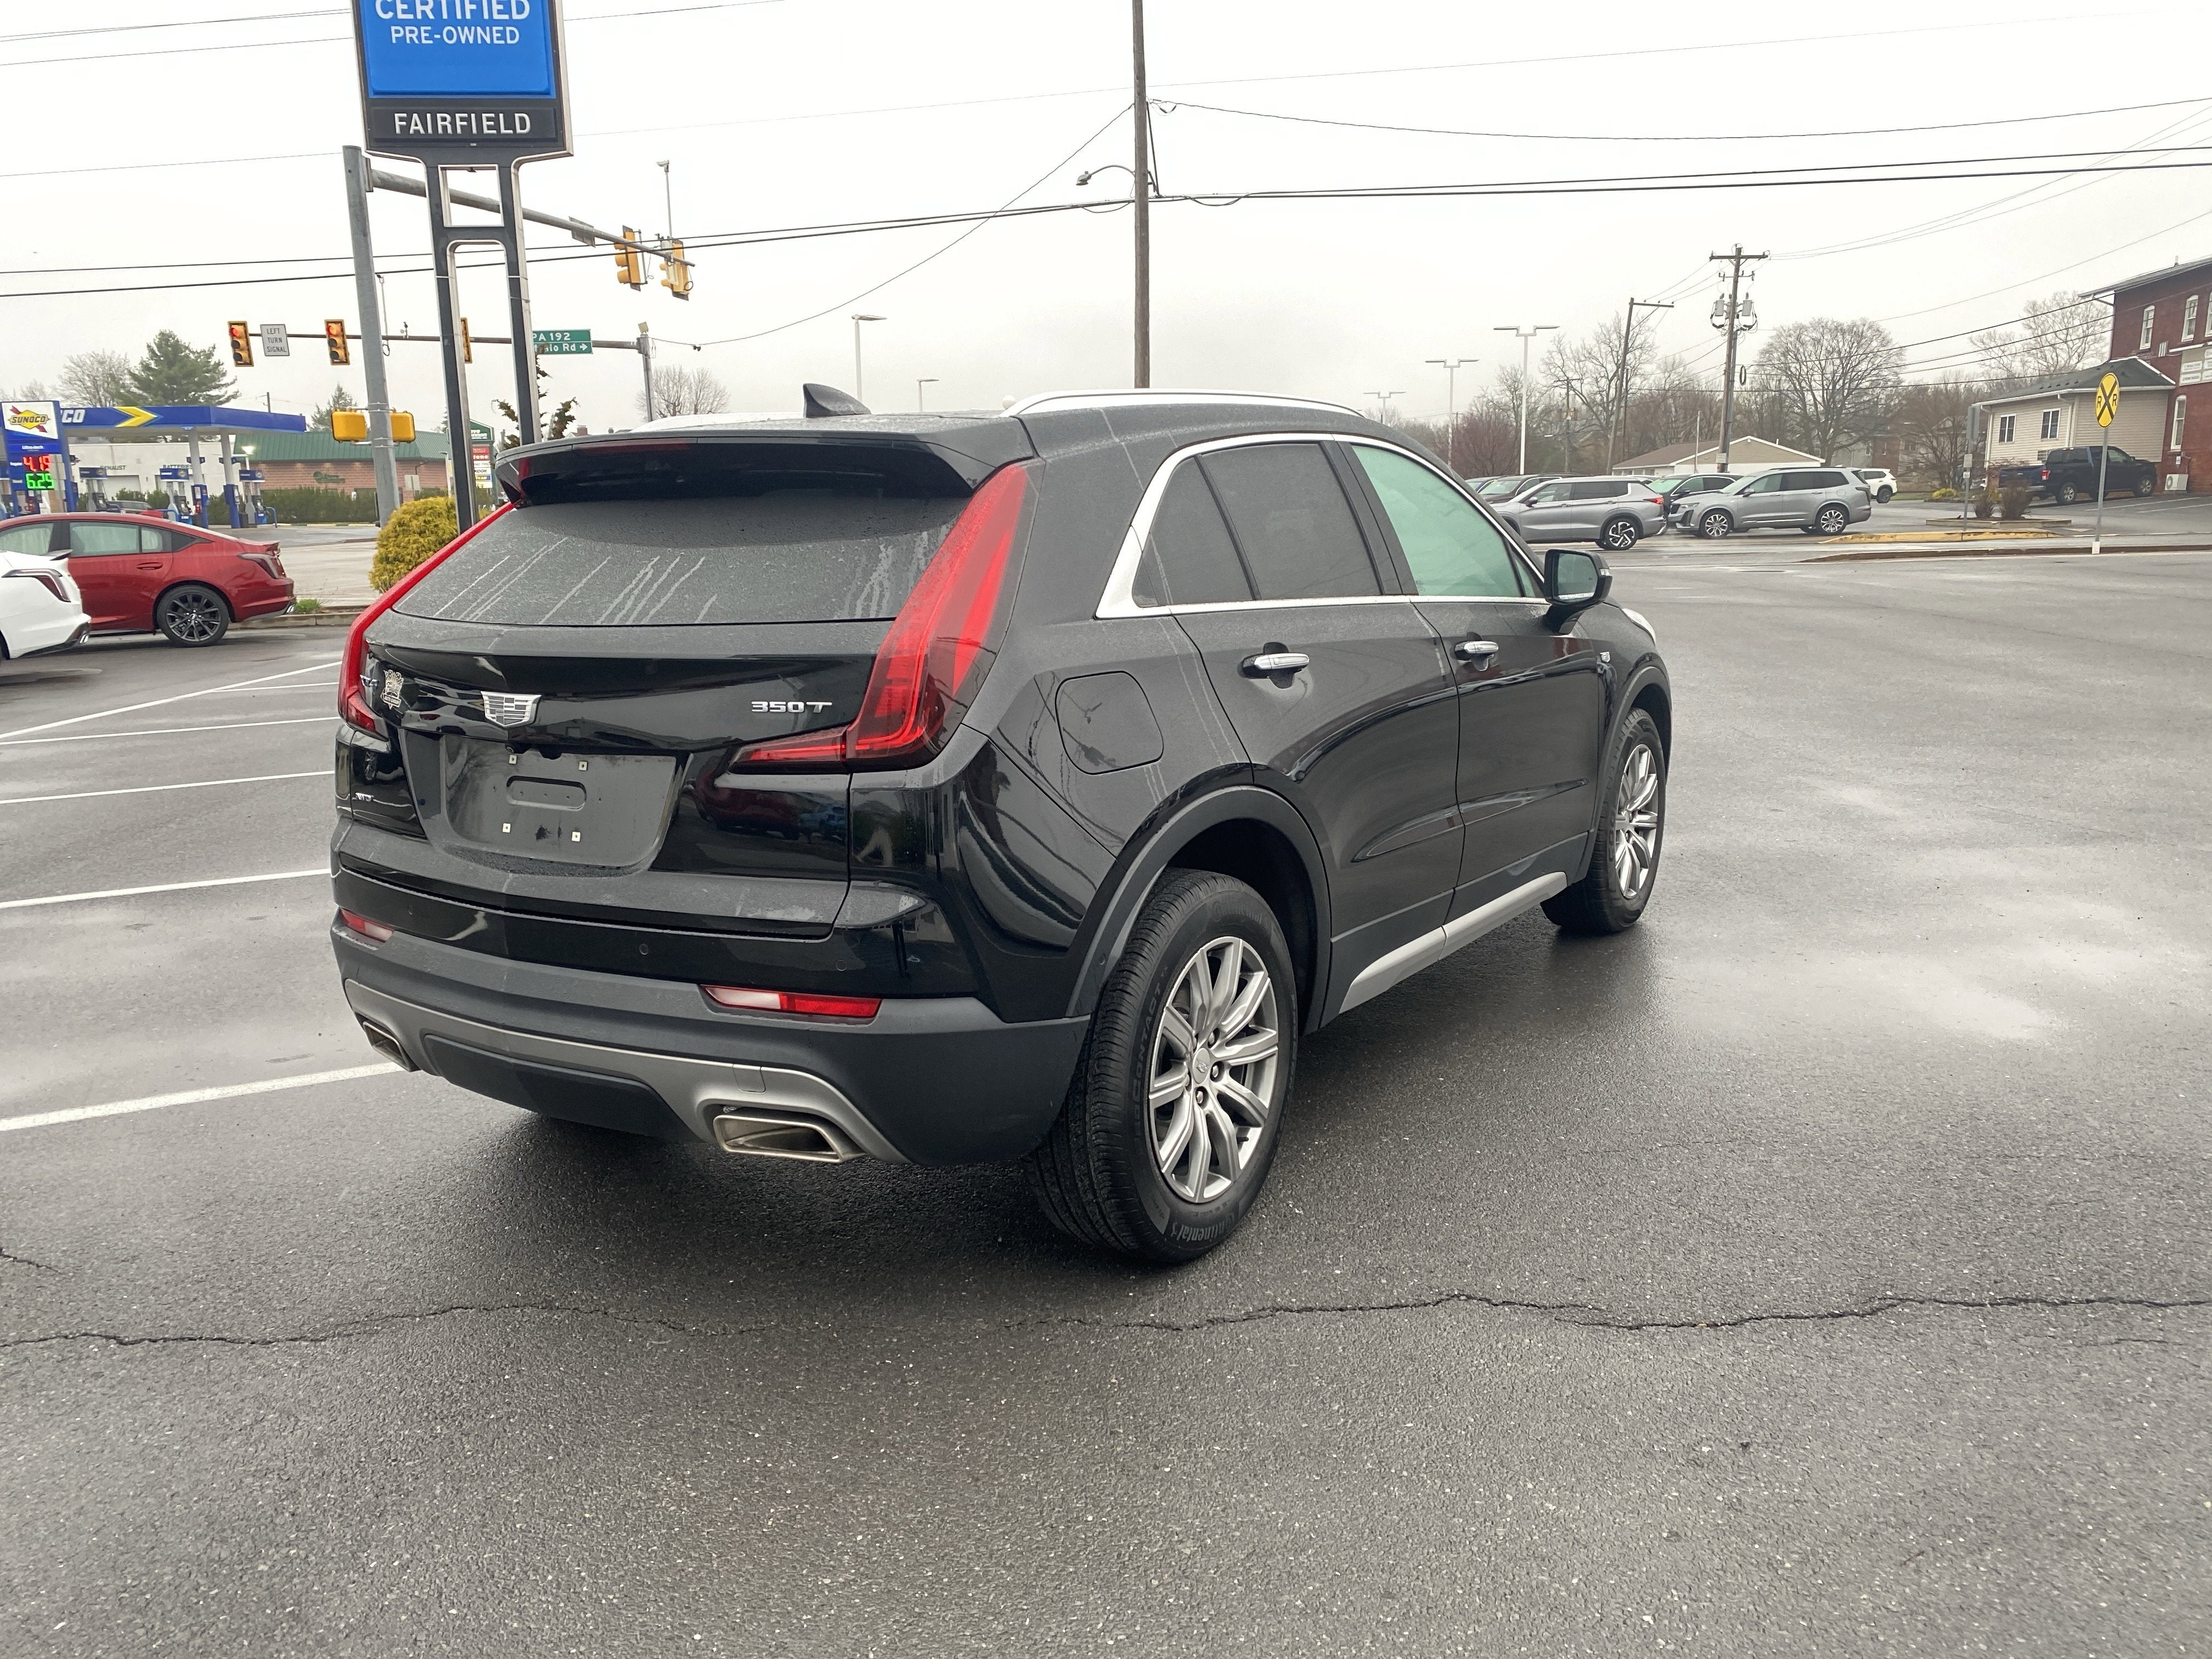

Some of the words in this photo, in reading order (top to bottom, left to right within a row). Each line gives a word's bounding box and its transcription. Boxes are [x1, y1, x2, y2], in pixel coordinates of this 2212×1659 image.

[375, 0, 531, 20] CERTIFIED
[390, 26, 520, 45] PRE-OWNED
[394, 112, 532, 135] FAIRFIELD
[532, 332, 546, 341] PA
[549, 332, 571, 341] 192
[562, 343, 576, 351] Rd
[2097, 396, 2102, 409] R
[2112, 393, 2117, 407] R
[60, 409, 85, 423] CO
[751, 701, 832, 713] 350T
